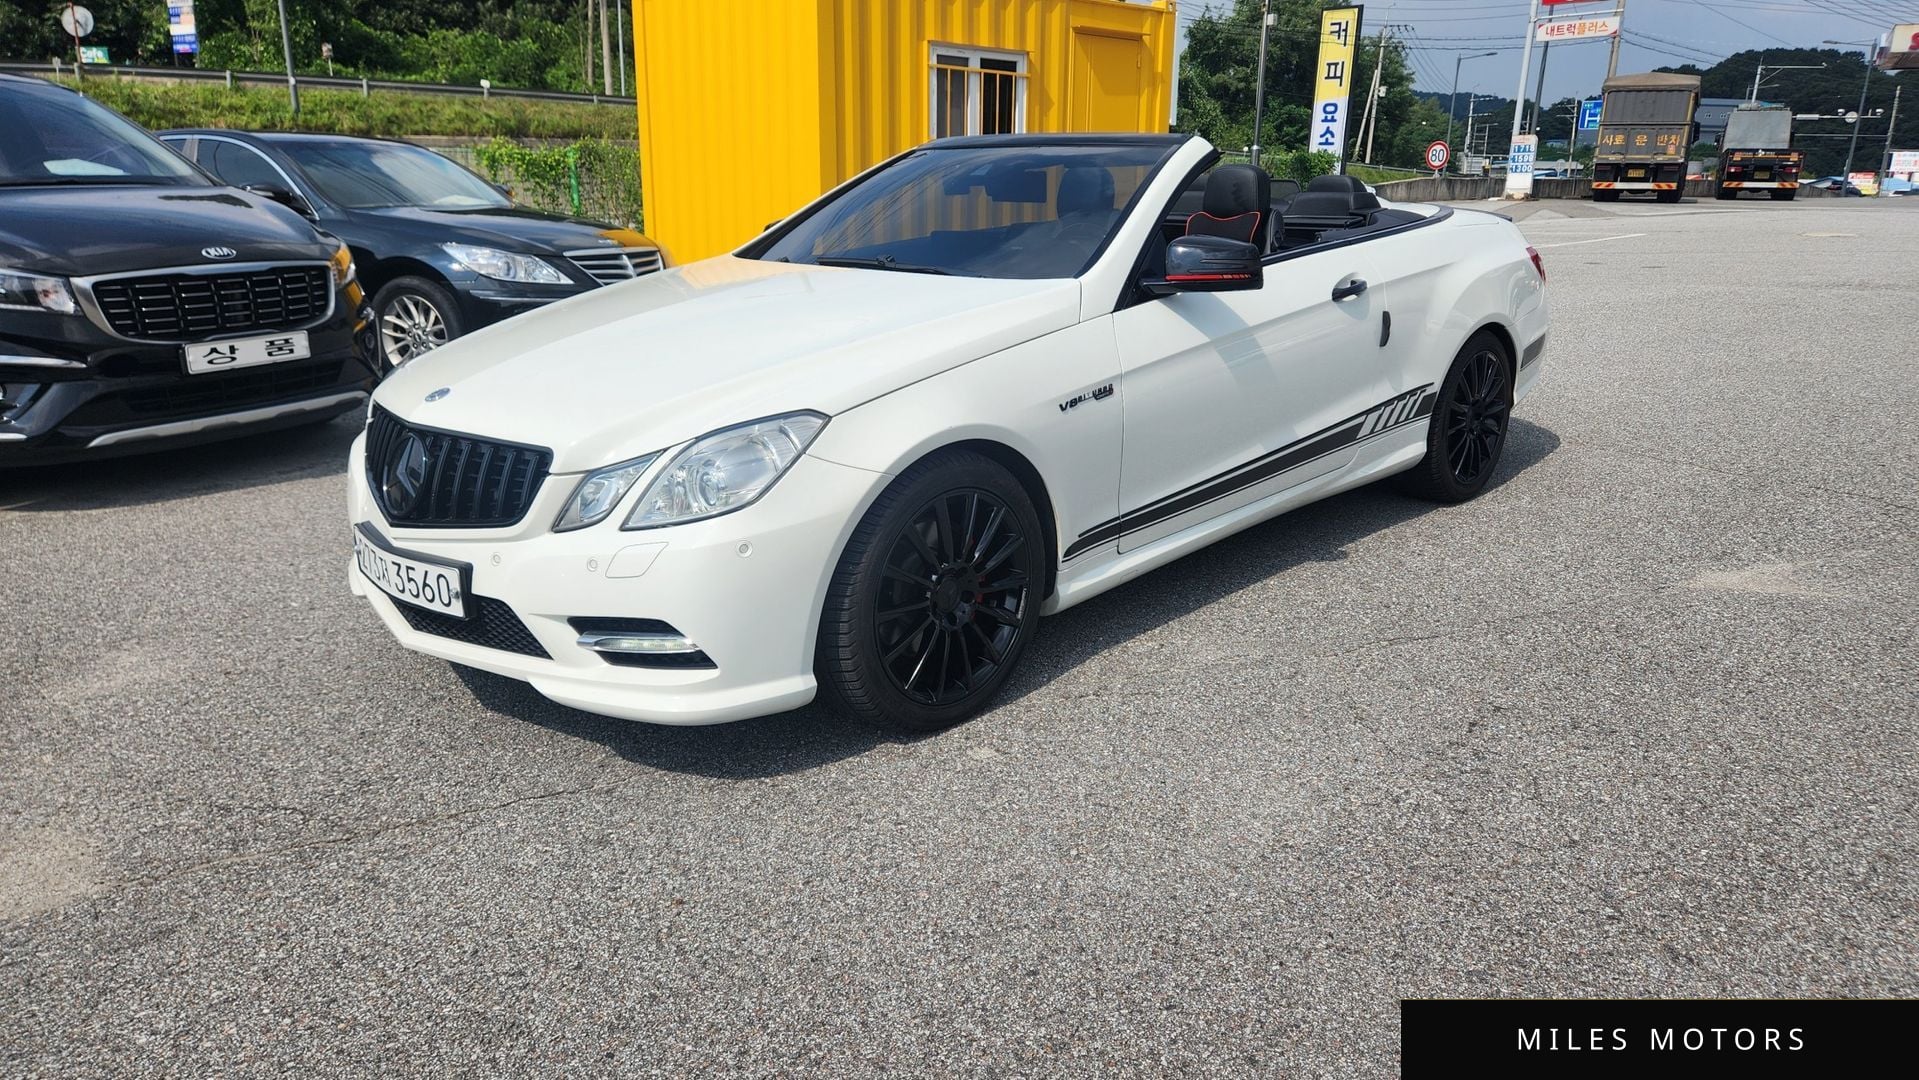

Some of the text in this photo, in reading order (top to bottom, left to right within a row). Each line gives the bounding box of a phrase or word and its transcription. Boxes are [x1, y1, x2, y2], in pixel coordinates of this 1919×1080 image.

[1545, 21, 1609, 37] 내트럭플러스
[1318, 102, 1339, 152] 요소
[1430, 148, 1445, 162] 80
[206, 247, 234, 257] KIA
[391, 560, 452, 608] 3560
